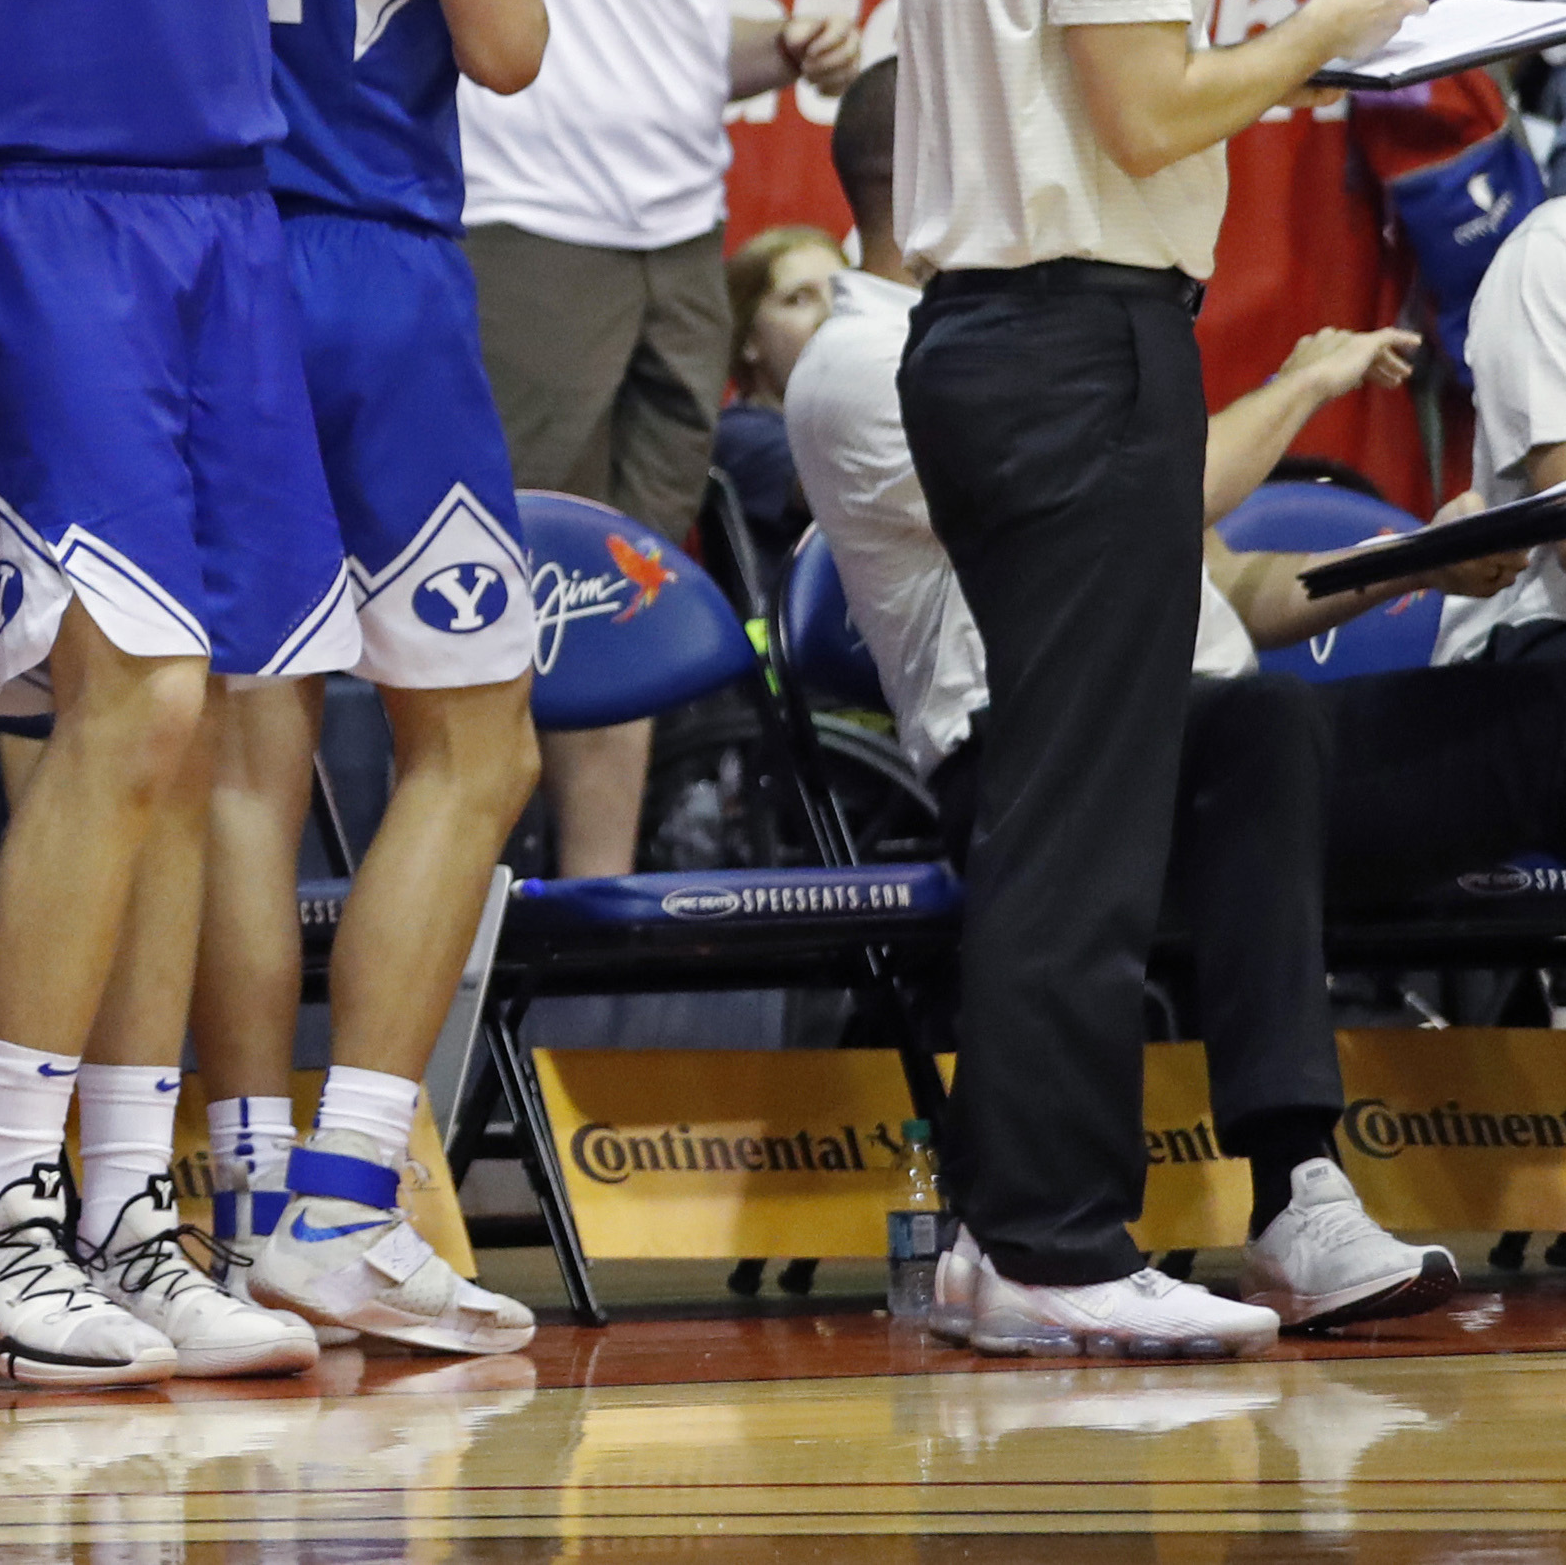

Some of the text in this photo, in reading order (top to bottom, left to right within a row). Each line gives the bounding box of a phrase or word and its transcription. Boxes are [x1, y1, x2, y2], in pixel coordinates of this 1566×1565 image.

[424, 566, 499, 631] Y
[742, 884, 911, 912] SPECSEATS.COM
[571, 1122, 867, 1184] Continental
[1343, 1099, 1566, 1159] Continen
